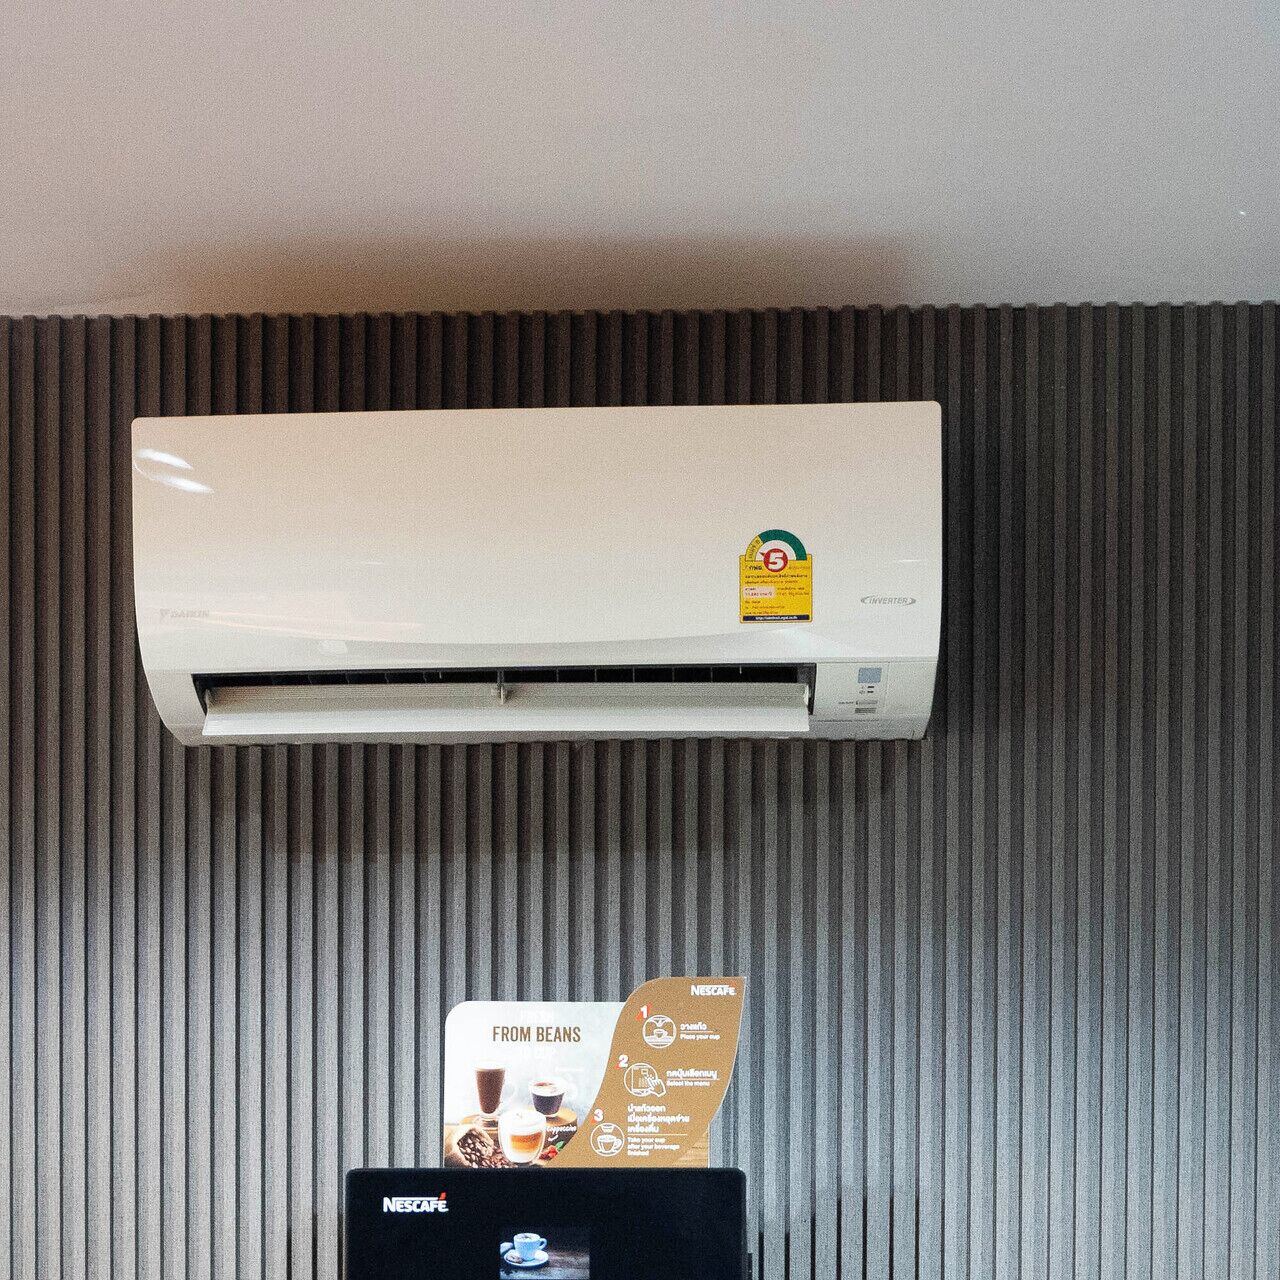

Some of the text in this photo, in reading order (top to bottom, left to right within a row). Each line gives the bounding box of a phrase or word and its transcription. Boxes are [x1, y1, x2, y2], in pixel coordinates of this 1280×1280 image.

[768, 552, 784, 571] 5
[869, 596, 908, 605] INVERTER
[640, 1005, 648, 1019] 1
[492, 1026, 581, 1042] FROM BEANS
[618, 1055, 629, 1068] 2
[593, 1108, 604, 1122] 3
